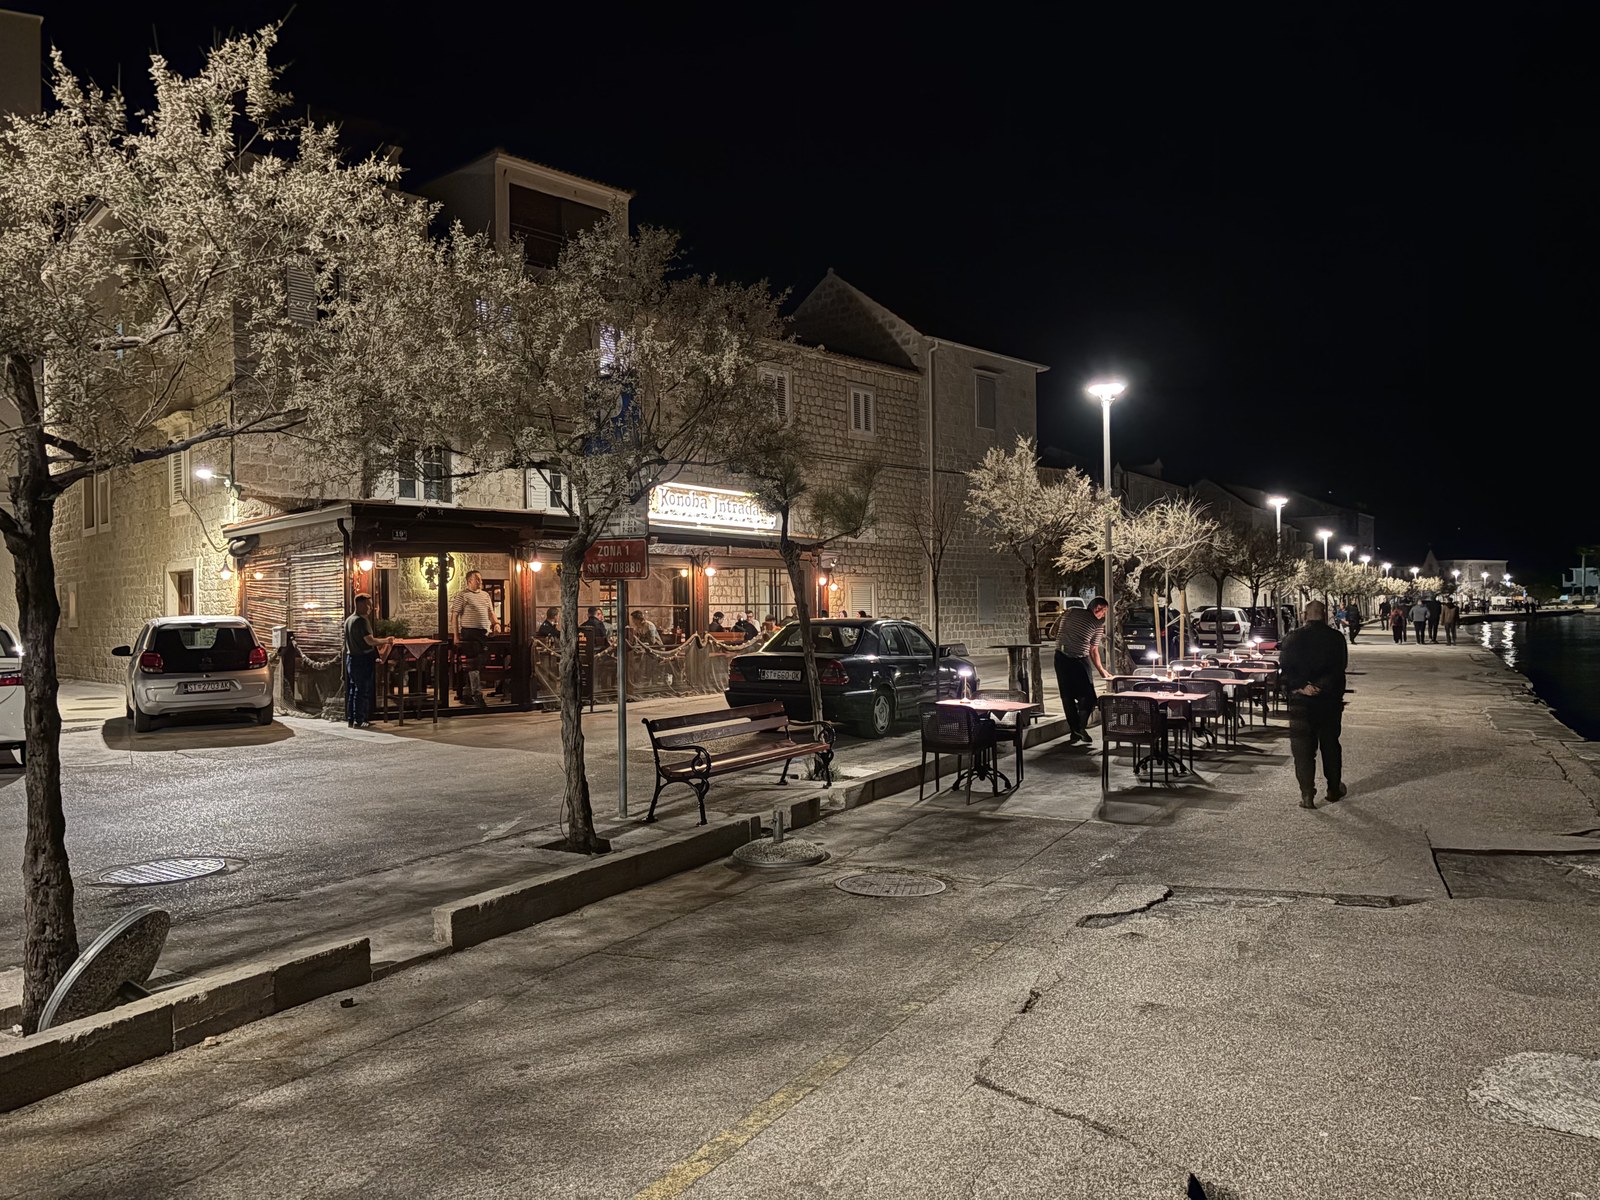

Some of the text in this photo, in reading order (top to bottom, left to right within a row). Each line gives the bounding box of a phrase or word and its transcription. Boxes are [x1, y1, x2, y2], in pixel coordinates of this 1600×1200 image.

[597, 545, 630, 557] ZONA 1
[587, 562, 641, 574] SMS 708880
